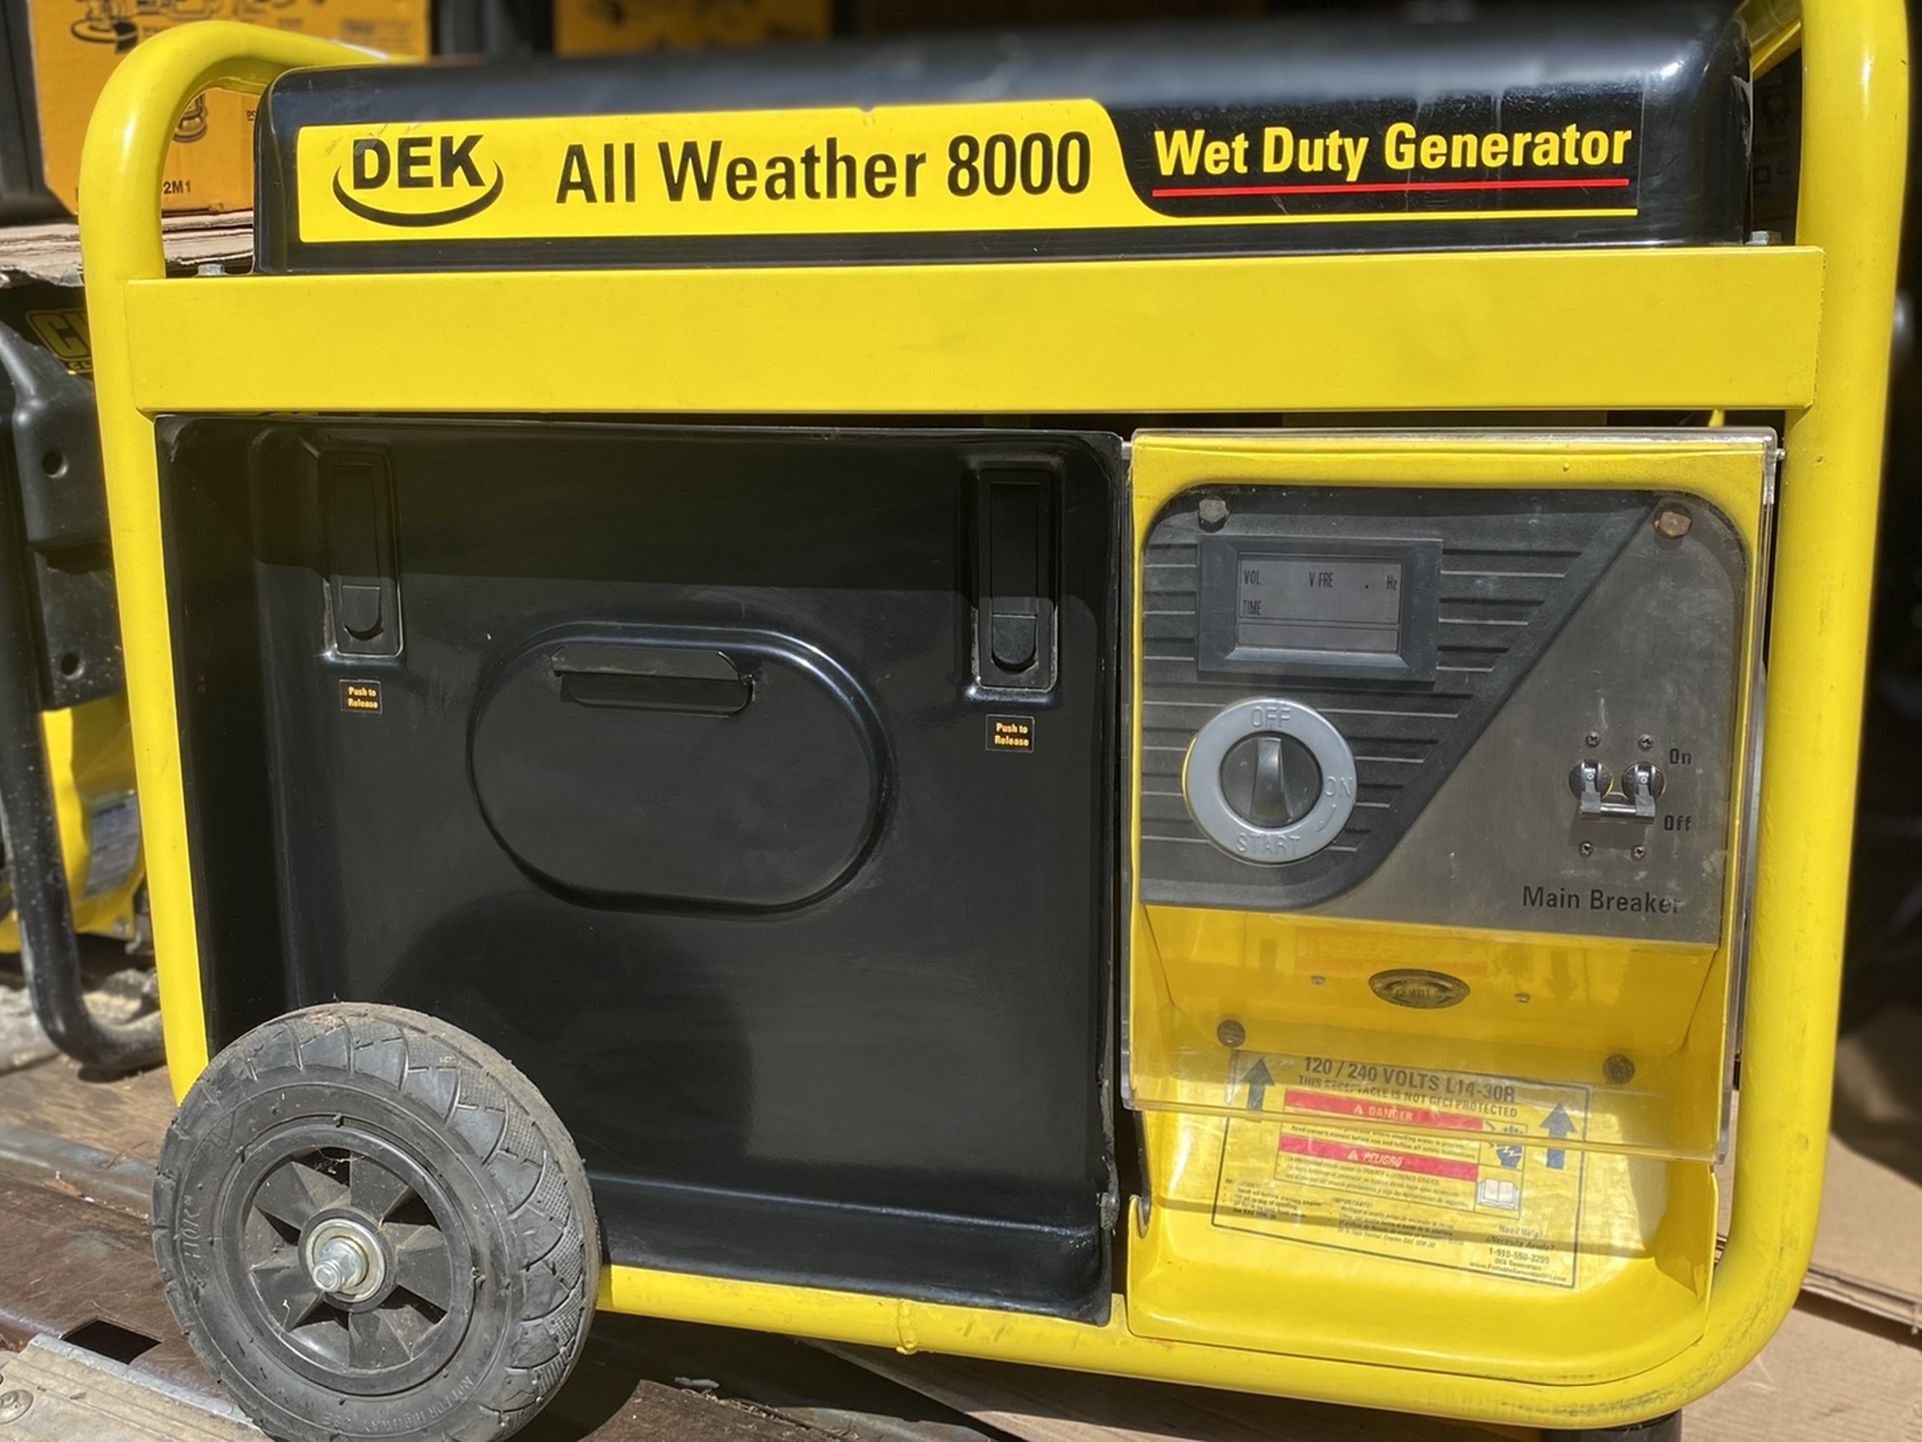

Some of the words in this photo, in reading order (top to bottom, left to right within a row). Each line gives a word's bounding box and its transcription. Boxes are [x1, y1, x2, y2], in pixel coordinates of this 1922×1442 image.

[351, 134, 486, 191] DEK
[1154, 128, 1249, 176] Wet
[1263, 126, 1369, 182] Duty
[1384, 122, 1631, 169] Generator
[556, 142, 635, 204] All
[658, 137, 927, 202] Weather
[947, 131, 1091, 197] 8000
[1244, 570, 1261, 585] VOL
[1309, 572, 1316, 587] V
[1318, 572, 1334, 588] FRE
[1387, 575, 1398, 591] Hz
[1243, 599, 1262, 616] TIME
[348, 686, 367, 696] Push
[368, 688, 377, 697] to
[347, 698, 379, 709] Release
[1251, 705, 1291, 728] OFF
[996, 722, 1018, 733] Push
[1019, 725, 1029, 734] to
[994, 735, 1030, 747] Release
[1669, 748, 1692, 765] On
[1325, 775, 1354, 799] ON
[1664, 815, 1694, 831] Off
[1236, 832, 1301, 857] START
[1522, 885, 1580, 909] Main
[1590, 889, 1682, 914] Breaker
[1304, 1056, 1332, 1075] 120
[1347, 1063, 1377, 1081] 240
[1383, 1067, 1439, 1092] VOLTS
[1445, 1077, 1516, 1103] L14-30R
[1298, 1075, 1322, 1088] THIS
[1391, 1088, 1401, 1100] IS
[1404, 1091, 1425, 1104] NOT
[1455, 1098, 1518, 1118] PROTECTED
[1368, 1105, 1414, 1122] DANGER
[1362, 1152, 1404, 1168] PELIGRO
